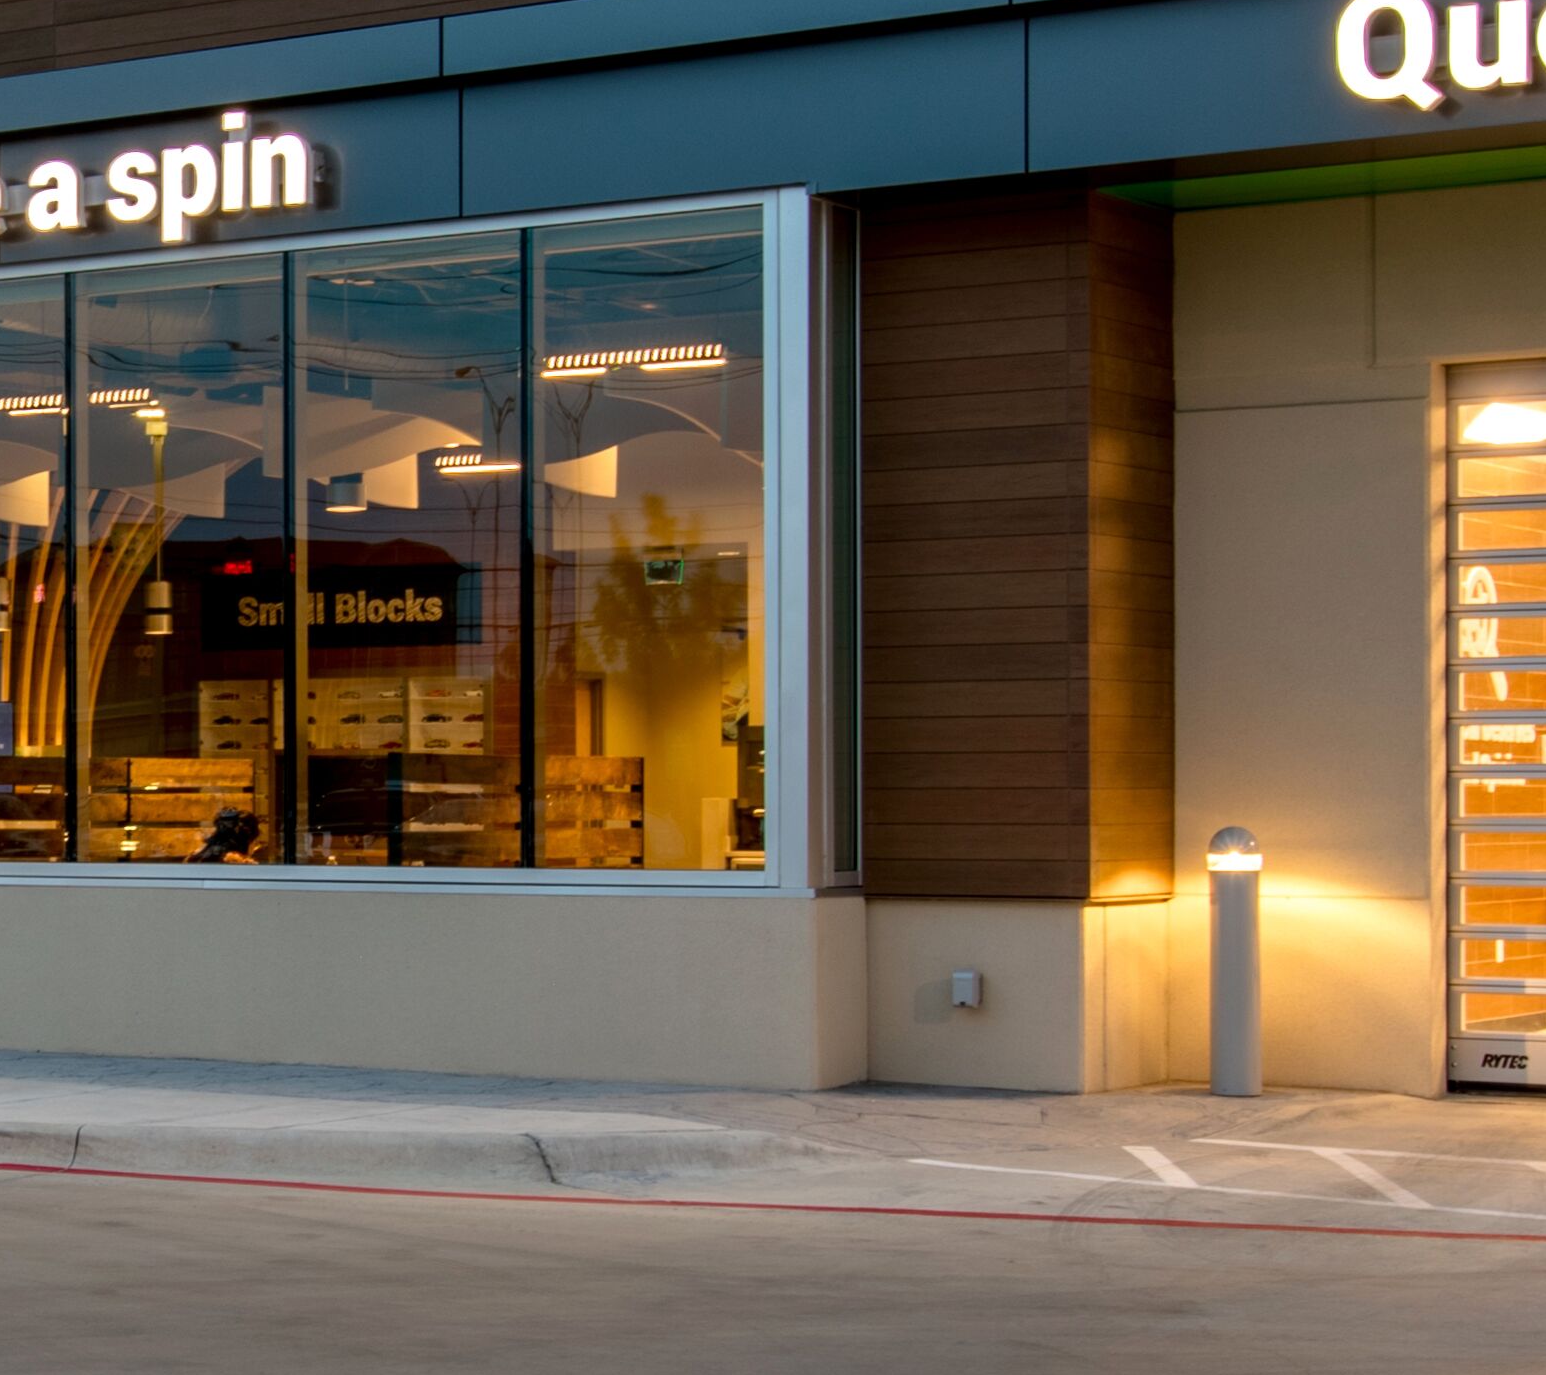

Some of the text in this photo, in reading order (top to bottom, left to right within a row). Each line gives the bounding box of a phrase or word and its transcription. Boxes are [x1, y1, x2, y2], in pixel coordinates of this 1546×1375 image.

[28, 160, 83, 232] a
[107, 110, 309, 244] spin
[238, 588, 444, 627] Smll Blocks
[1481, 1053, 1528, 1069] RYTEC
